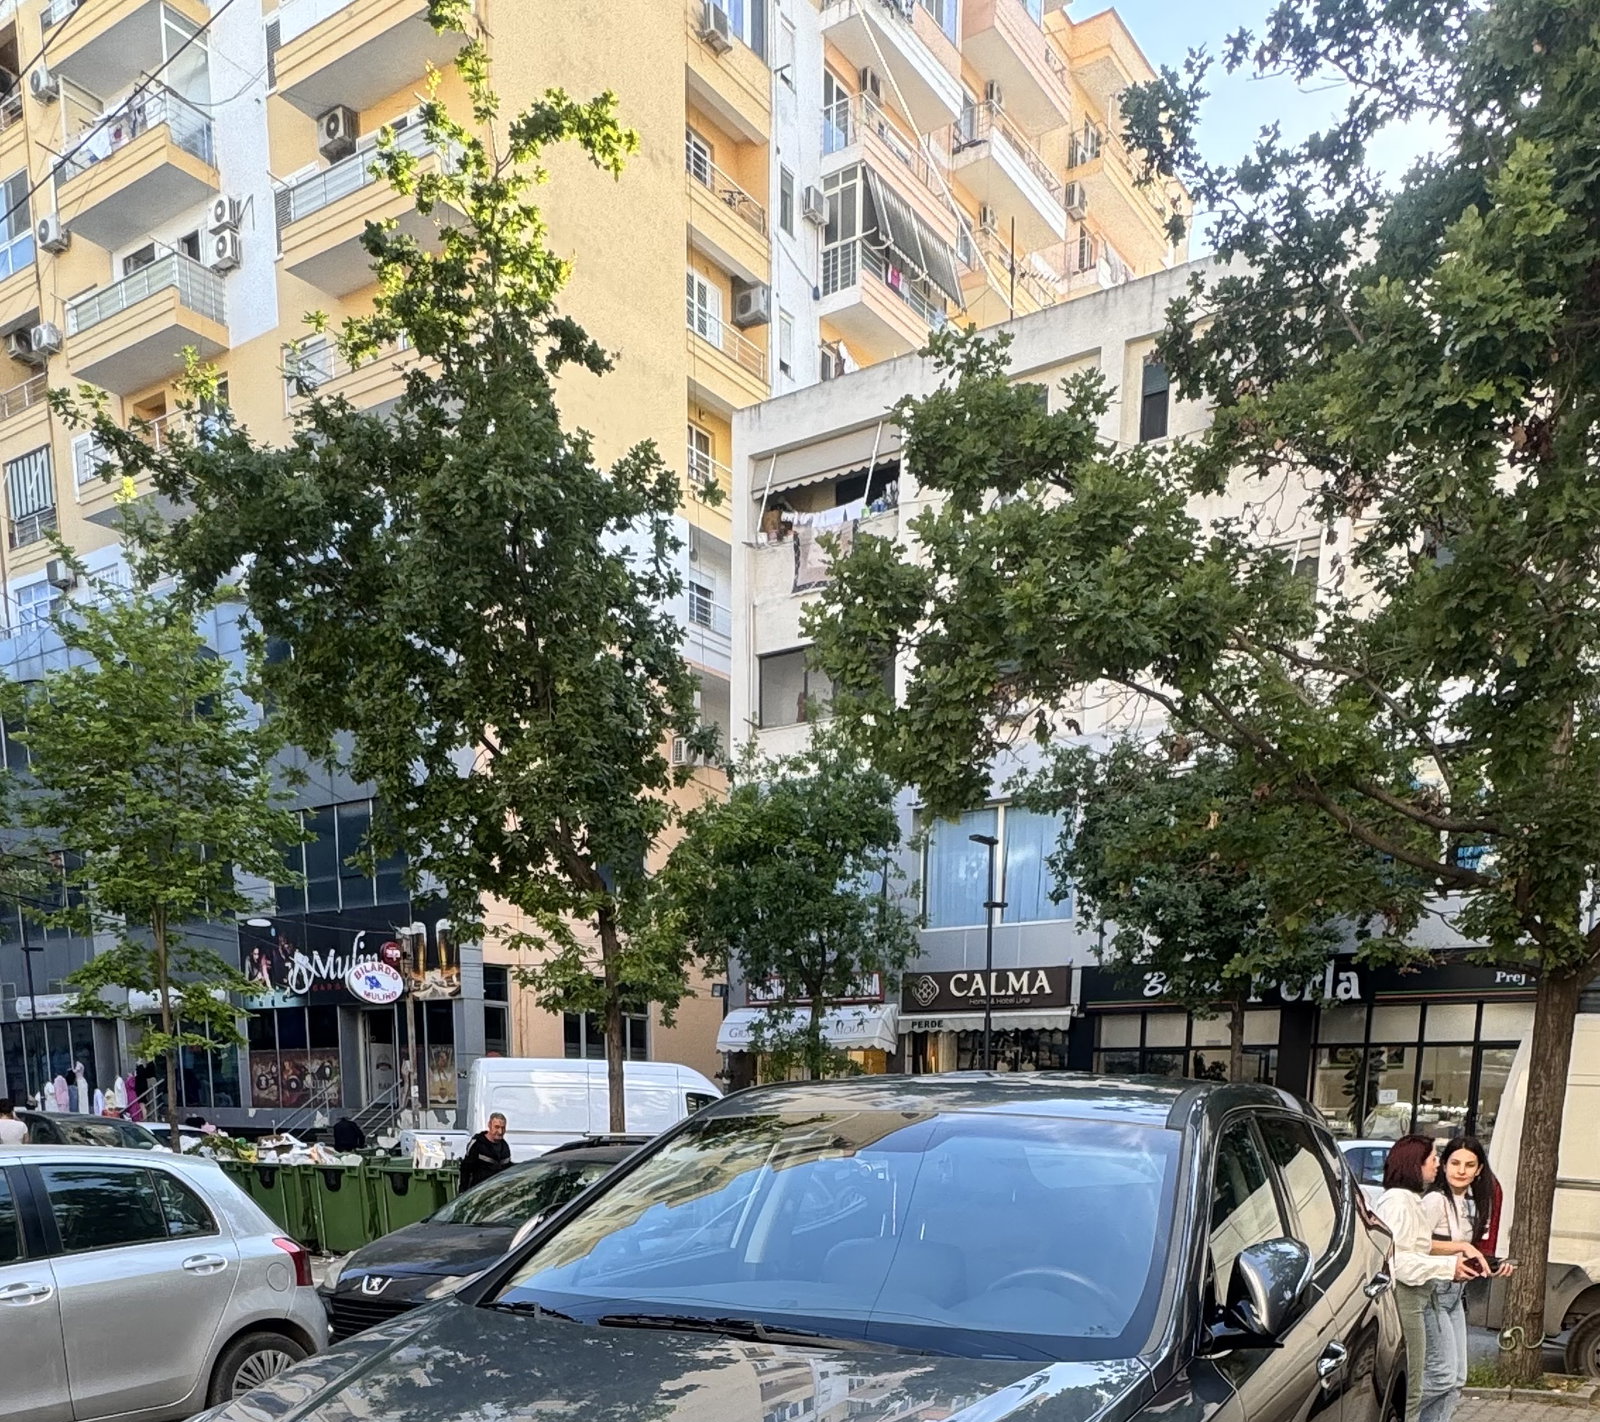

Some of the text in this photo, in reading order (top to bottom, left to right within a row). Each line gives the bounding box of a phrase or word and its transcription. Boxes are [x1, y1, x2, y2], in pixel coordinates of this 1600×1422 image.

[353, 963, 399, 981] BILARDO
[1495, 971, 1526, 986] Prej
[950, 970, 1052, 997] CALMA
[364, 990, 398, 1001] MULINO
[911, 1020, 944, 1029] PERDE
